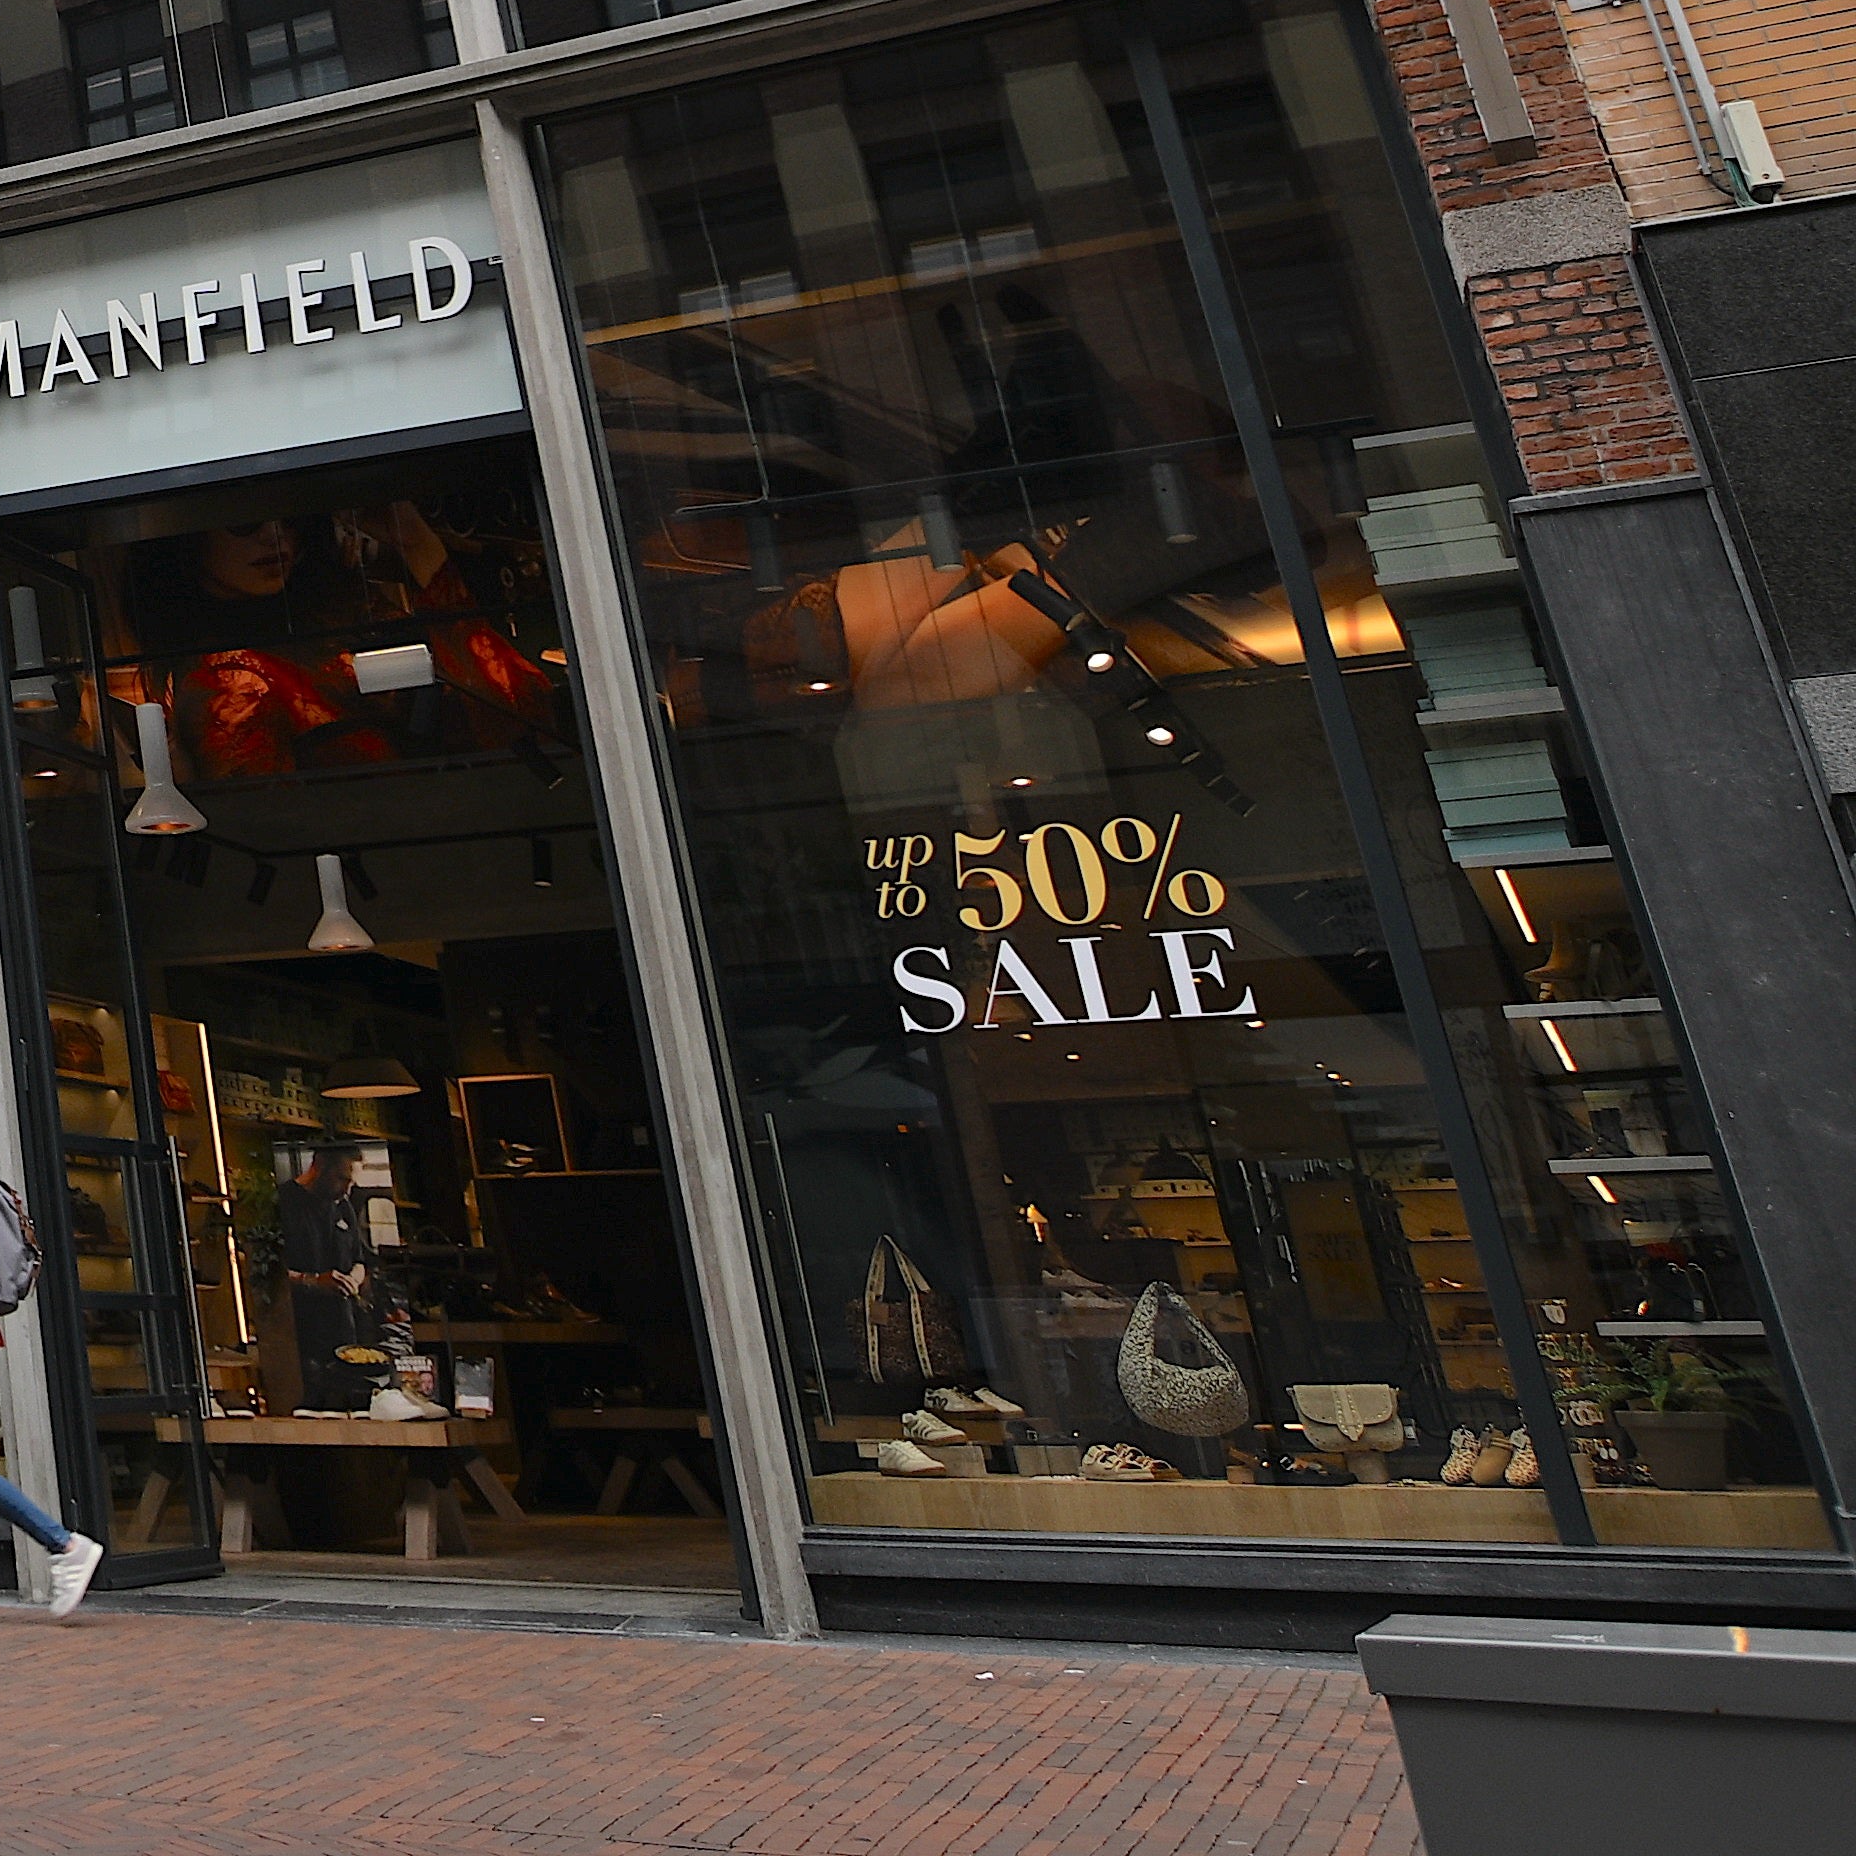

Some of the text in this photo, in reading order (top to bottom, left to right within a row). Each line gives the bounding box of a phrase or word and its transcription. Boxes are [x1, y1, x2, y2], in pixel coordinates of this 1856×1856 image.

[863, 834, 933, 885] up
[954, 813, 1226, 931] 50%
[876, 882, 926, 919] to
[893, 928, 1257, 1033] SALE
